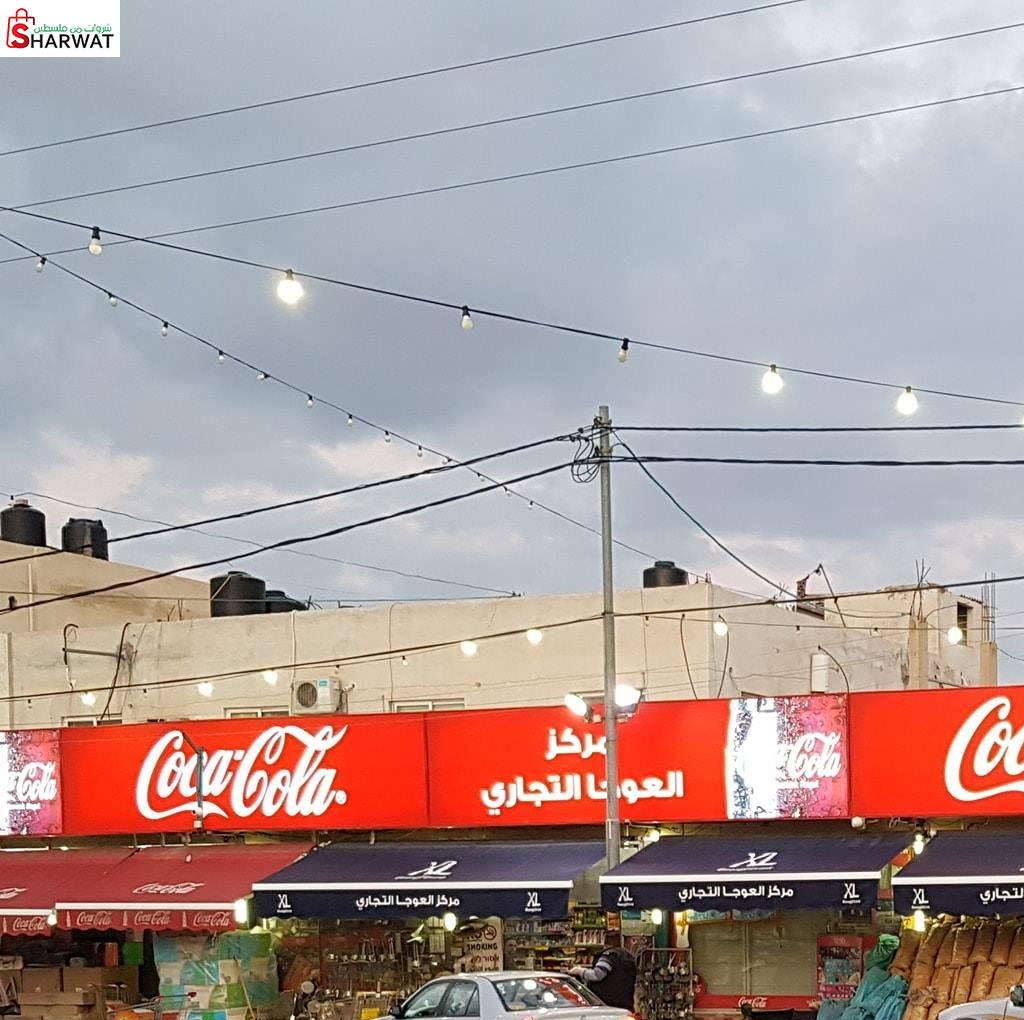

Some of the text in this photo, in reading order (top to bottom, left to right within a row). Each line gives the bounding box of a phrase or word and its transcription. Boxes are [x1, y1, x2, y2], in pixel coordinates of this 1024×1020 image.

[480, 773, 582, 816] التجاري
[618, 886, 634, 903] XL
[678, 886, 721, 903] التجاري
[767, 884, 794, 899] مركز
[843, 882, 860, 899] XL
[912, 888, 930, 905] XL
[277, 893, 292, 909] XL
[356, 896, 395, 911] التجاري
[434, 895, 460, 907] مركز
[526, 891, 541, 908] XL
